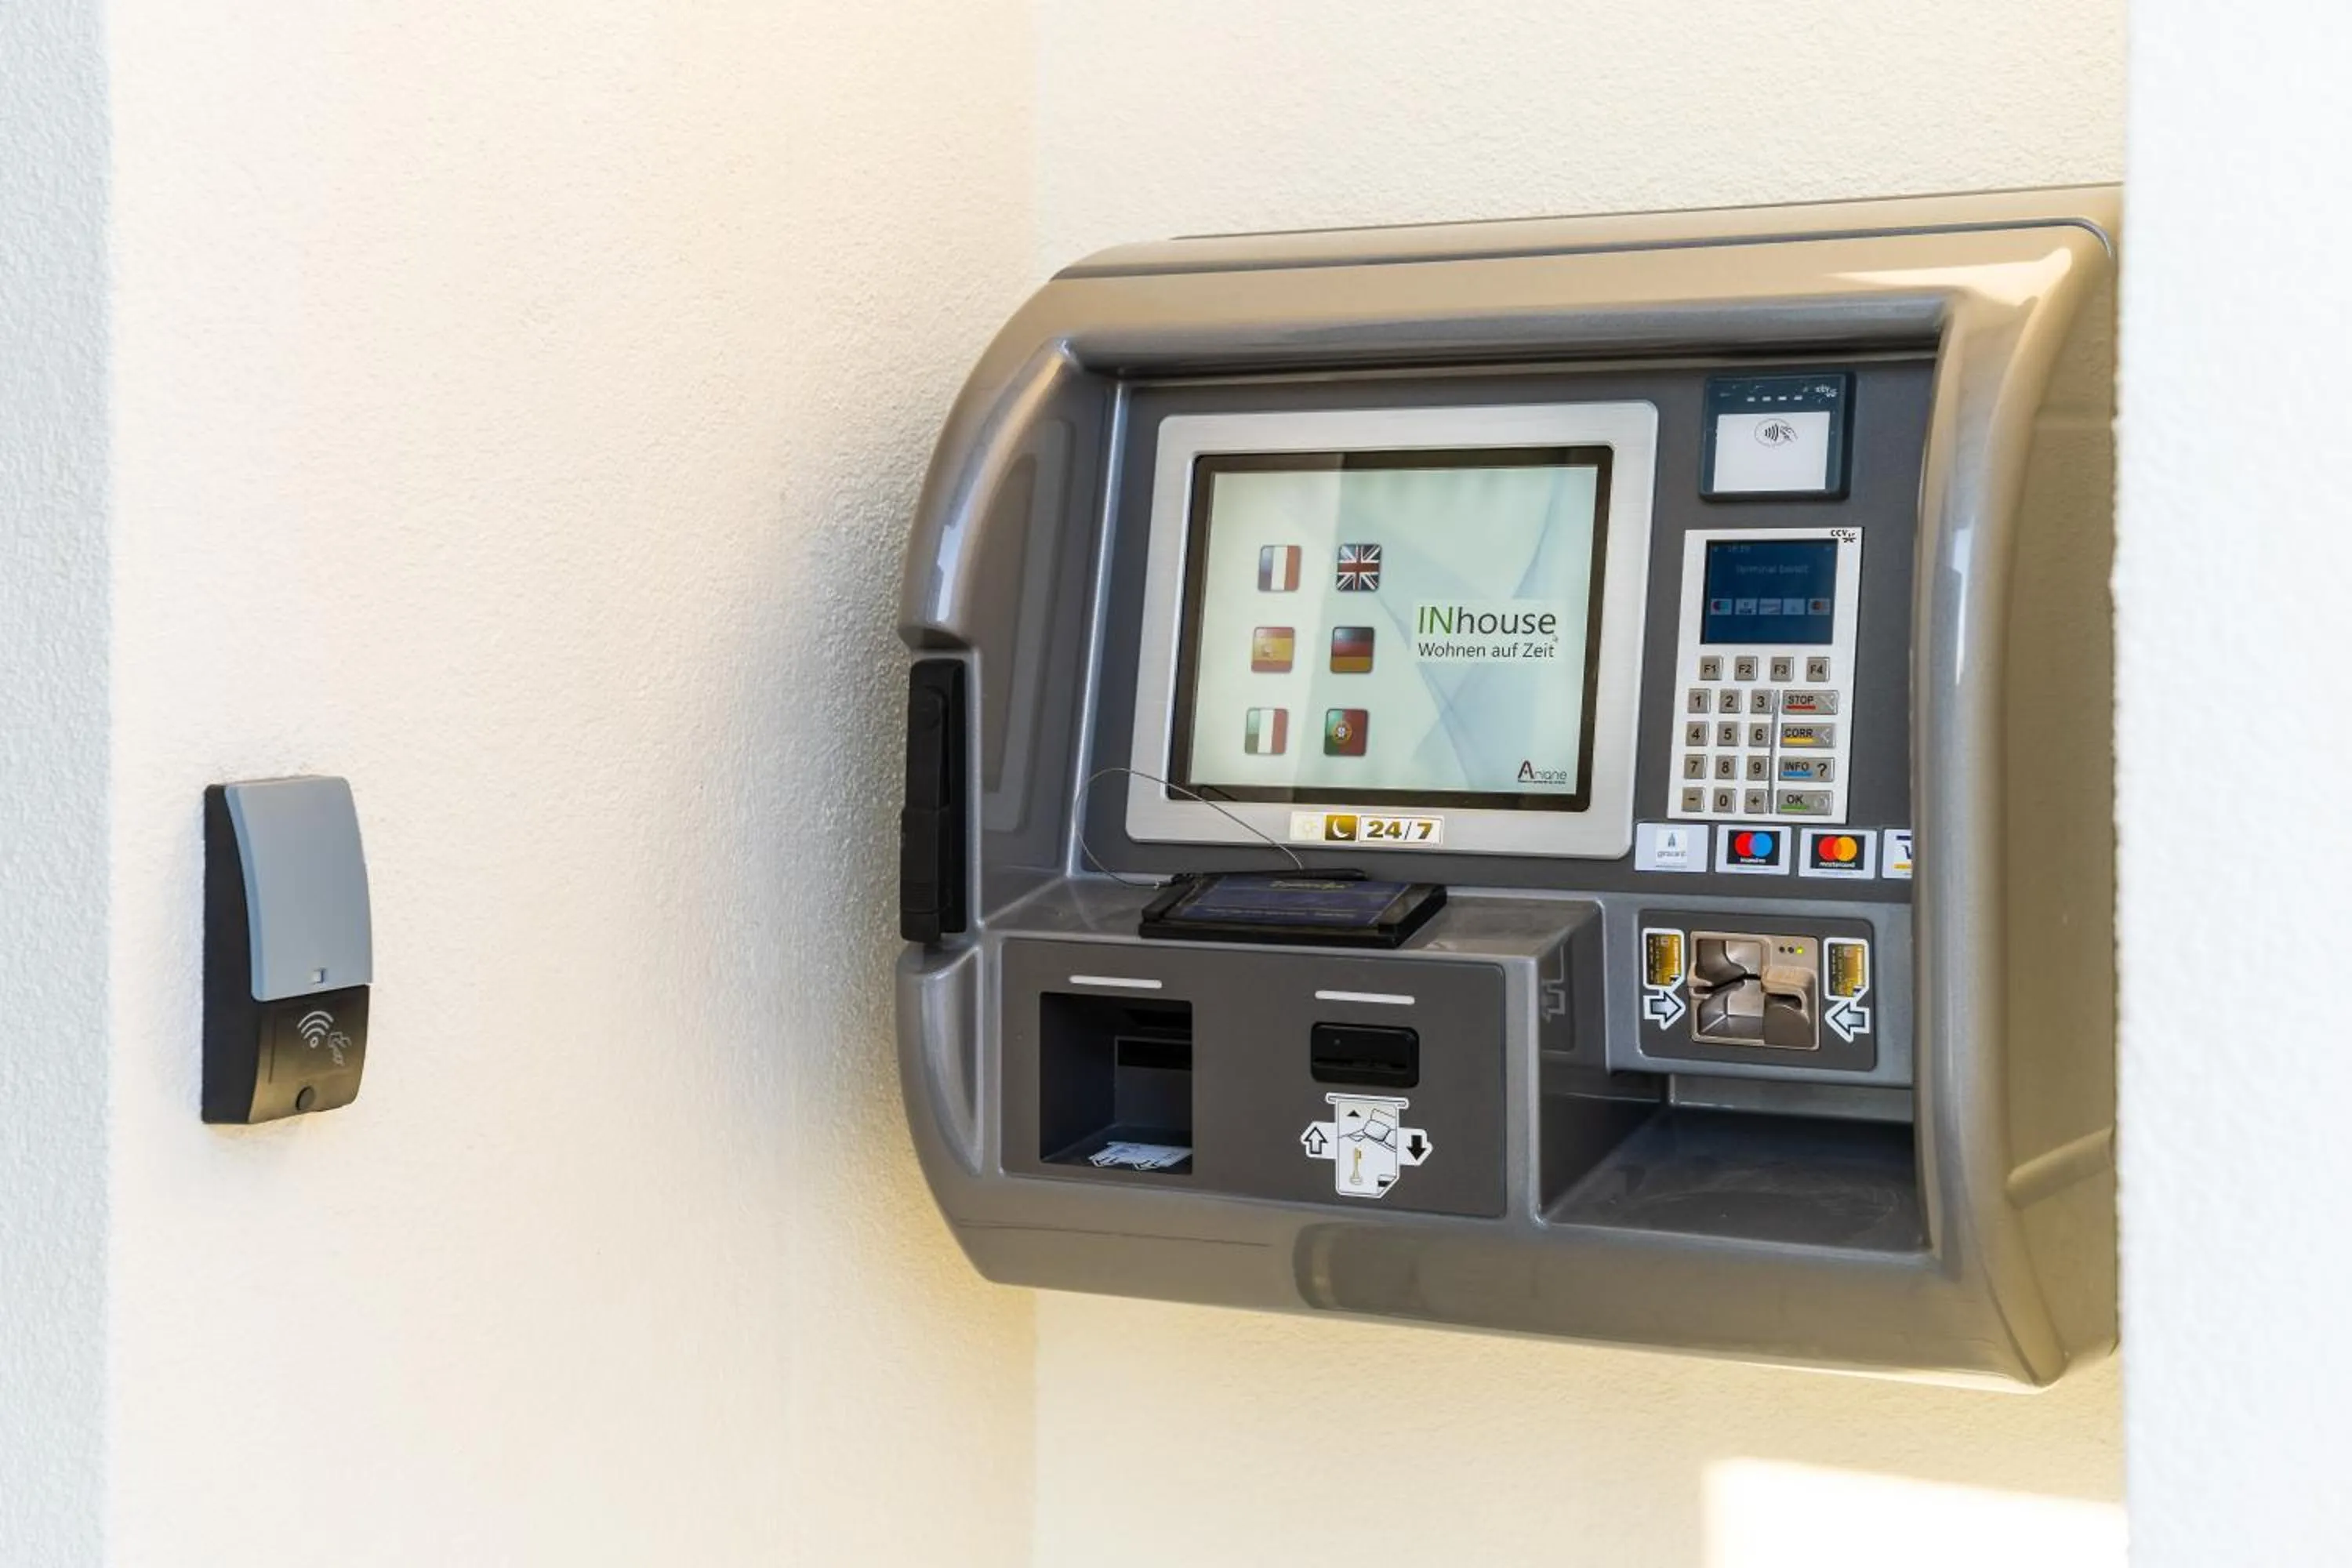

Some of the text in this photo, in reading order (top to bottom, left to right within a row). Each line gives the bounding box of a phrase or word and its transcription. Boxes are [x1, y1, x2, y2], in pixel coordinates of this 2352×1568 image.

[1417, 606, 1556, 635] INhouse
[1418, 642, 1555, 658] Wohnen auf Zeit
[1704, 666, 1717, 674] F1
[1738, 666, 1752, 674] F2
[1774, 666, 1788, 675] F3
[1810, 666, 1824, 675] F4
[1695, 695, 1701, 706] 1
[1725, 695, 1734, 707] 2
[1757, 696, 1766, 707] 3
[1788, 695, 1814, 704] STOP
[1691, 728, 1700, 739] 4
[1724, 728, 1733, 739] 5
[1755, 728, 1763, 740] 6
[1784, 728, 1813, 738] CORR
[1517, 760, 1567, 780] Ariane
[1690, 761, 1699, 772] 7
[1722, 761, 1730, 773] 8
[1752, 761, 1762, 774] 9
[1784, 761, 1828, 777] INFO ?
[1719, 794, 1728, 807] 0
[1787, 794, 1804, 804] OK
[1367, 820, 1434, 840] 24/7
